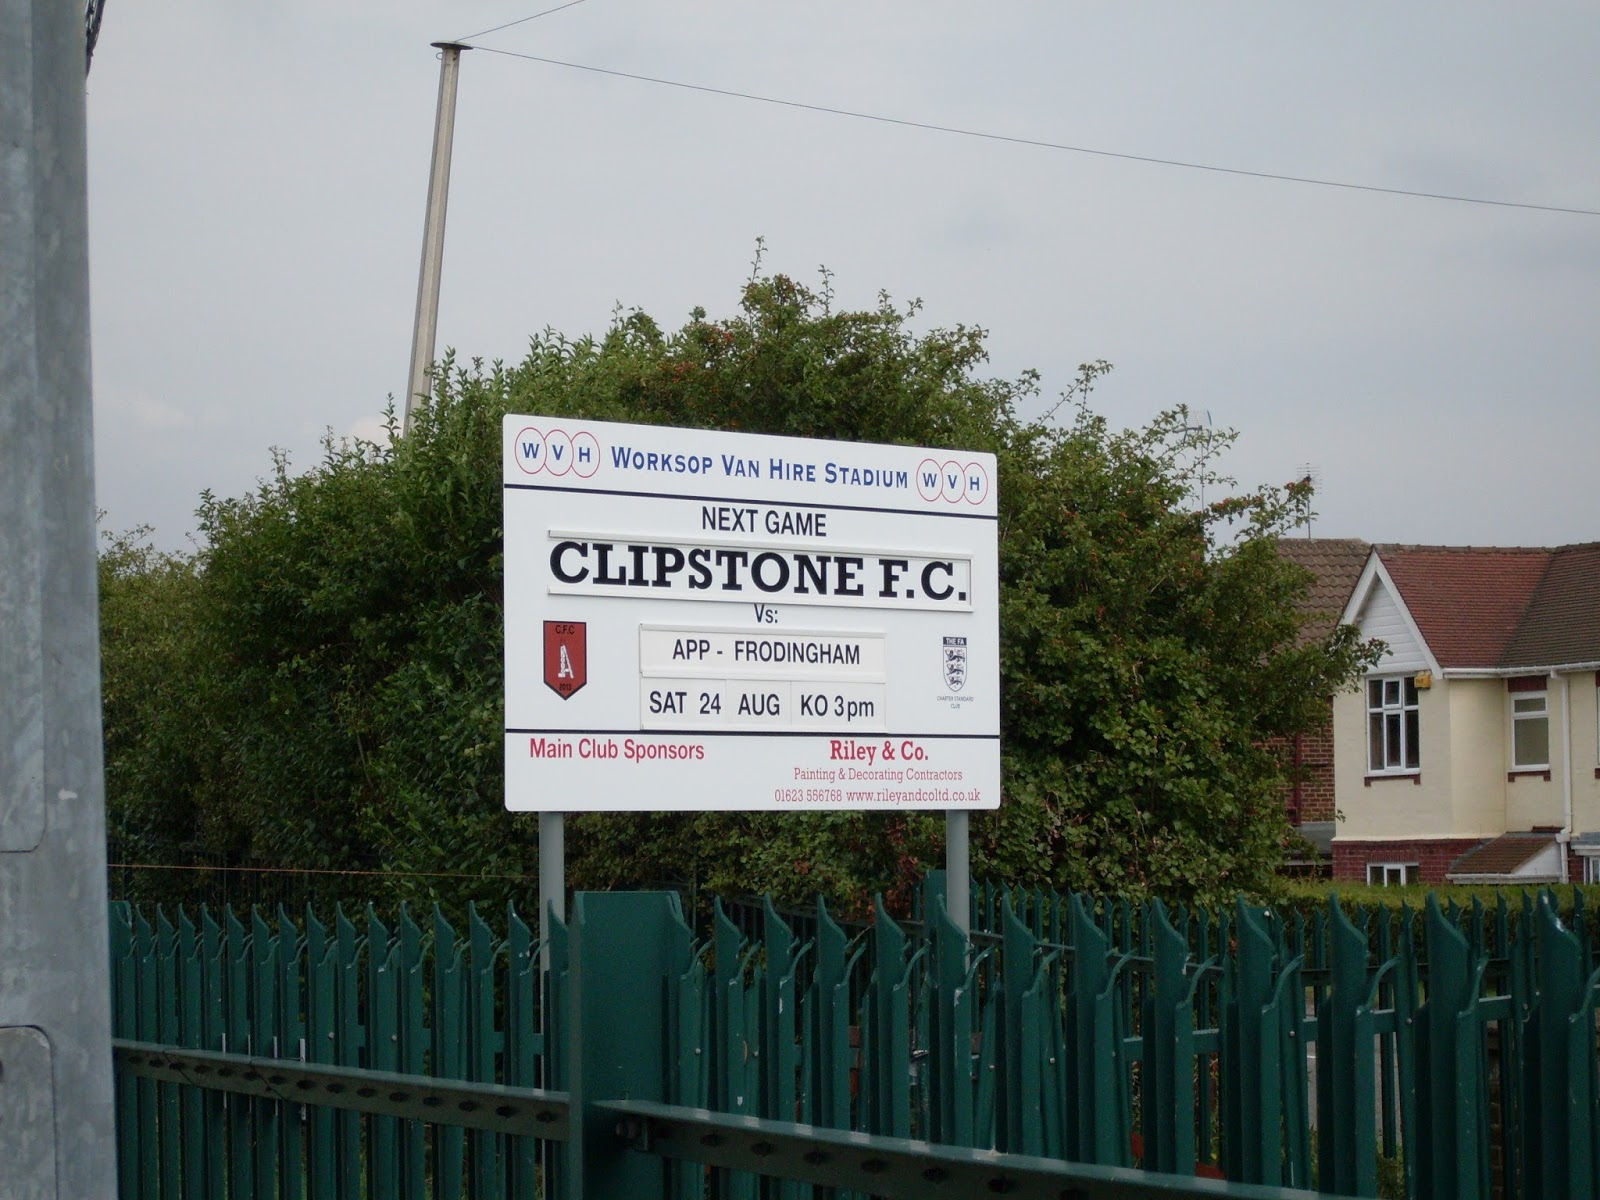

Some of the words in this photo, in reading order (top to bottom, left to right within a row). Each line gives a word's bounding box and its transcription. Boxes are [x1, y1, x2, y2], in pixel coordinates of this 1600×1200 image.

[611, 446, 713, 474] WORKSOP
[721, 455, 760, 478] VAN
[770, 459, 816, 482] HIRE
[825, 464, 907, 489] STADIUM
[702, 507, 758, 532] NEXT
[766, 511, 826, 536] GAME
[550, 541, 863, 596] CLIPSTONE
[879, 560, 967, 601] F.C.
[754, 603, 778, 623] Vs:
[673, 639, 710, 661] APP
[735, 641, 860, 664] FRODINGHAM
[649, 692, 687, 713] SAT
[700, 694, 721, 714] 24
[738, 694, 780, 716] AUG
[801, 696, 828, 716] KO
[834, 696, 874, 720] 3pm
[530, 739, 572, 759] Main
[578, 739, 618, 759] Club
[624, 740, 705, 763] Sponsors
[830, 740, 876, 765] Riley
[882, 741, 895, 760] &
[901, 741, 928, 760] Co.
[794, 768, 835, 783] Painting
[839, 769, 845, 780] &
[849, 769, 903, 783] Decorating
[906, 769, 962, 780] Contractors
[775, 790, 803, 801] 01623
[807, 790, 841, 801] 556768
[847, 788, 980, 805] www.rileyandcoltd.co.uk
